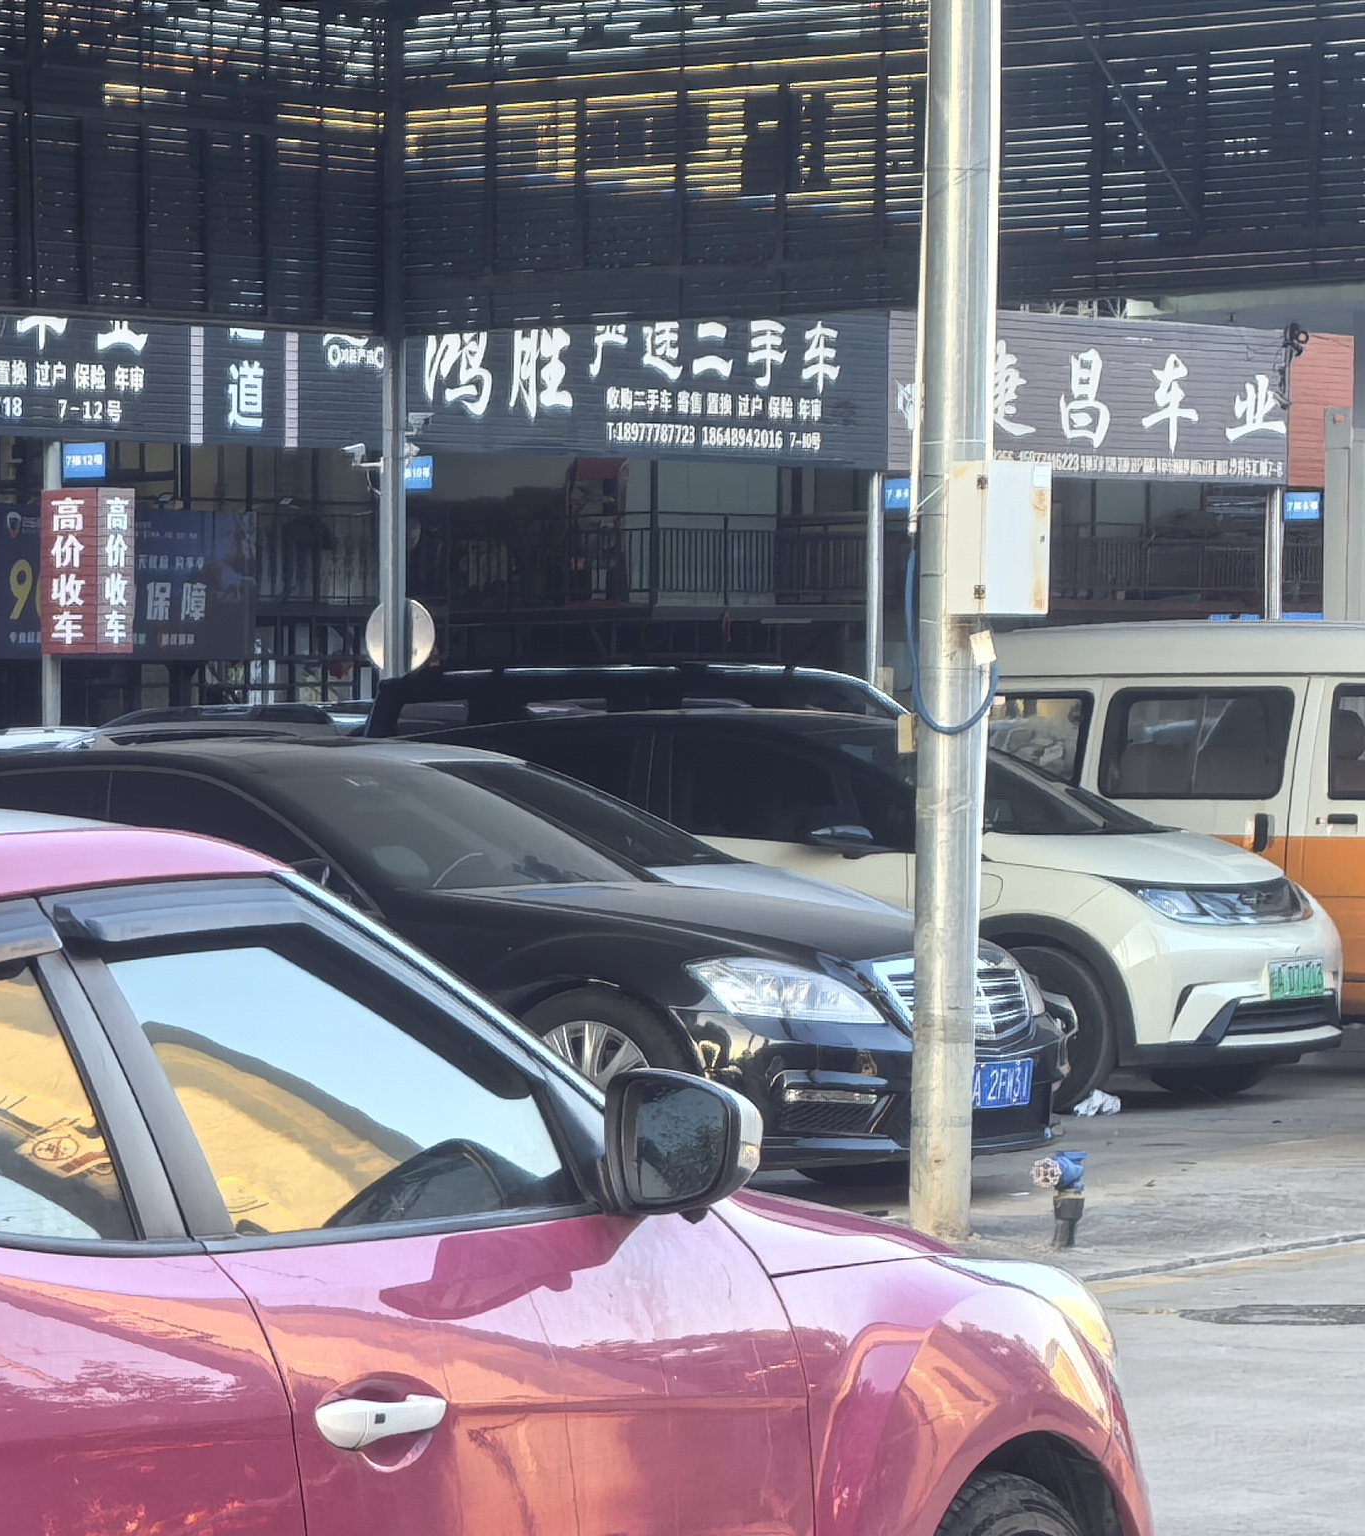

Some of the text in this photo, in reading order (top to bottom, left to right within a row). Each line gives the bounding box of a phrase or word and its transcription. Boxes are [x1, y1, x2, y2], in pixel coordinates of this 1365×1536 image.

[35, 360, 67, 389] 过户
[74, 361, 106, 391] 保险
[51, 497, 85, 645] 高价收车
[105, 497, 129, 645] 高价收车
